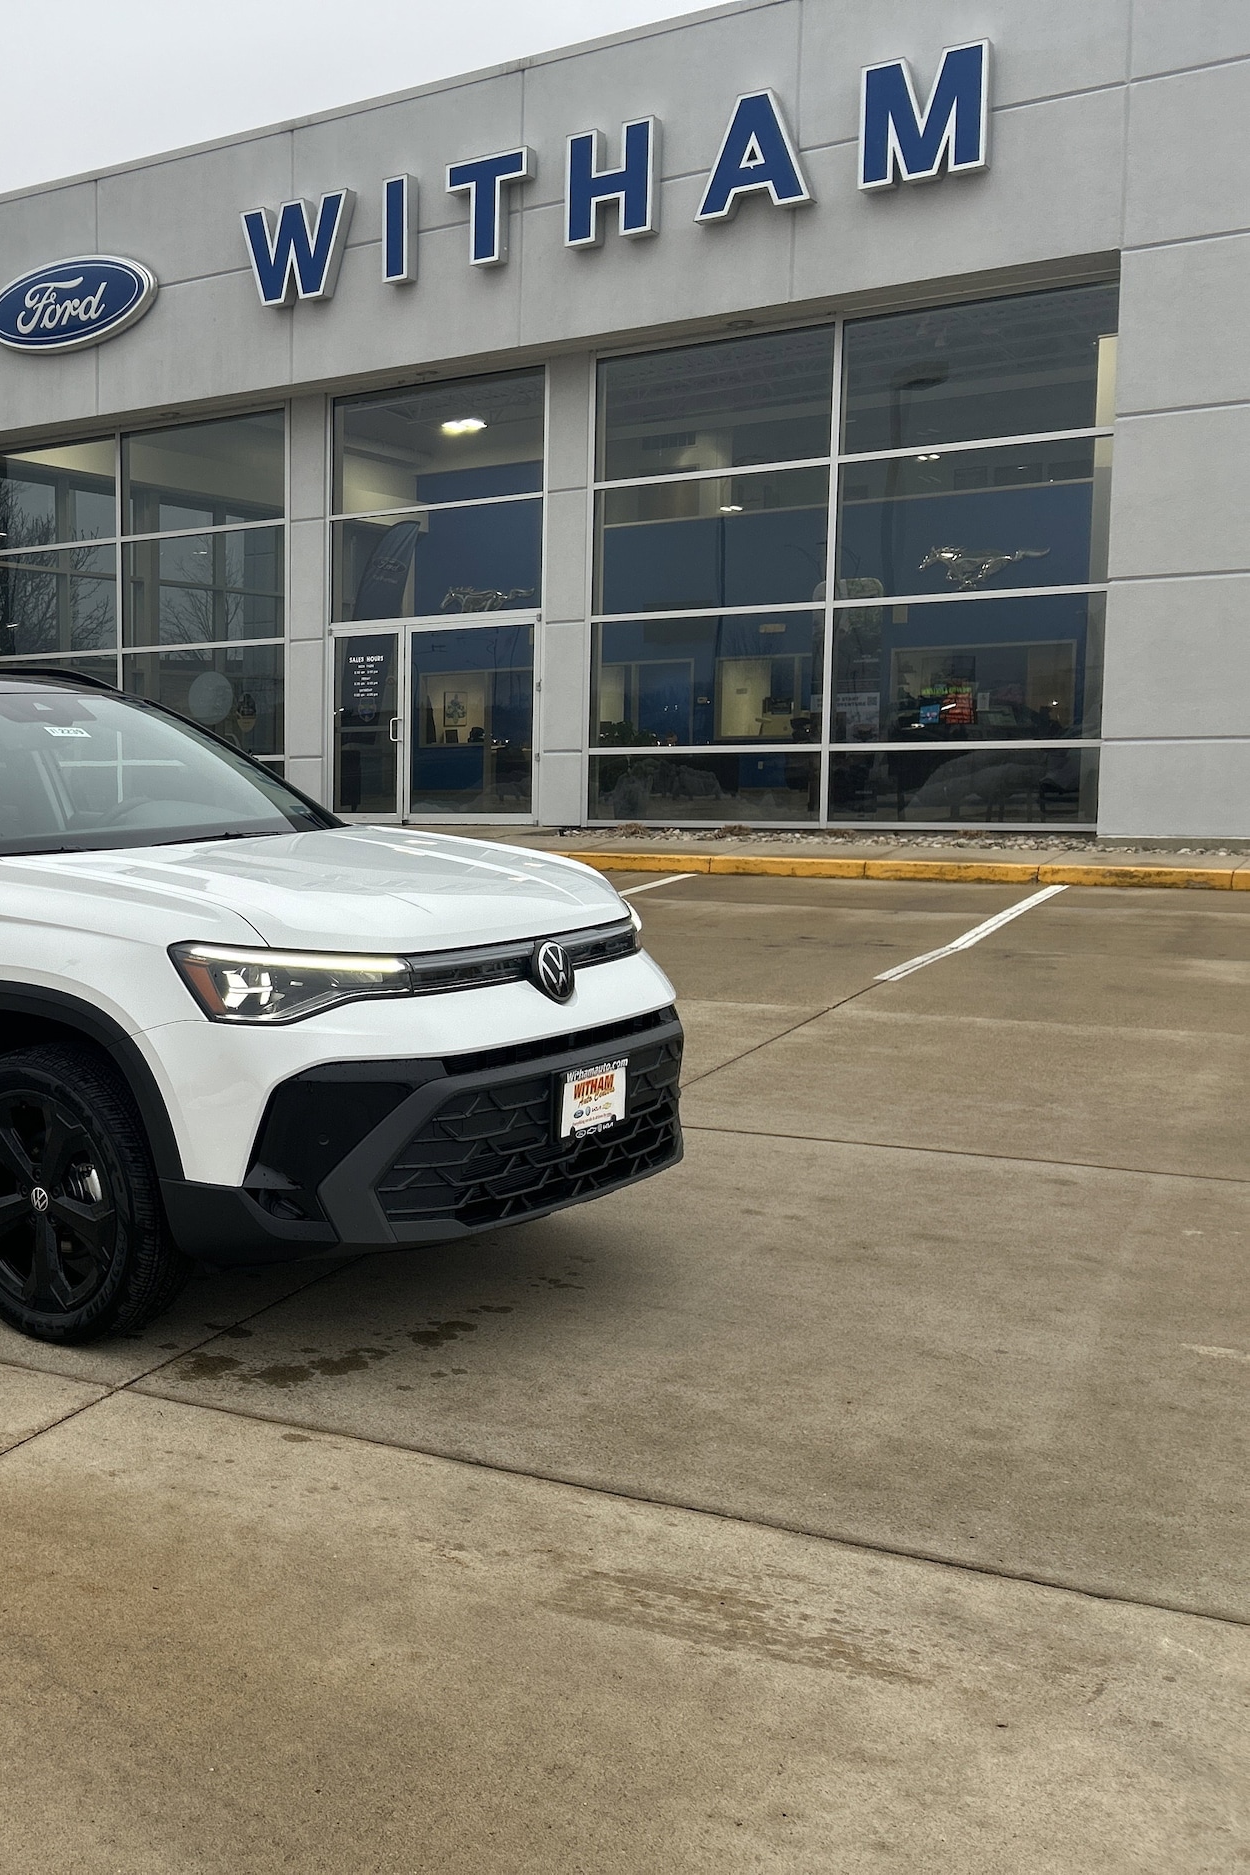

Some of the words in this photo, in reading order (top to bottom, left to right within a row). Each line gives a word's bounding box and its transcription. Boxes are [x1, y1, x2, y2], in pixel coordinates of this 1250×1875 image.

[240, 37, 992, 308] WITHAM
[17, 275, 107, 335] Ford
[574, 1074, 615, 1099] WITHAM
